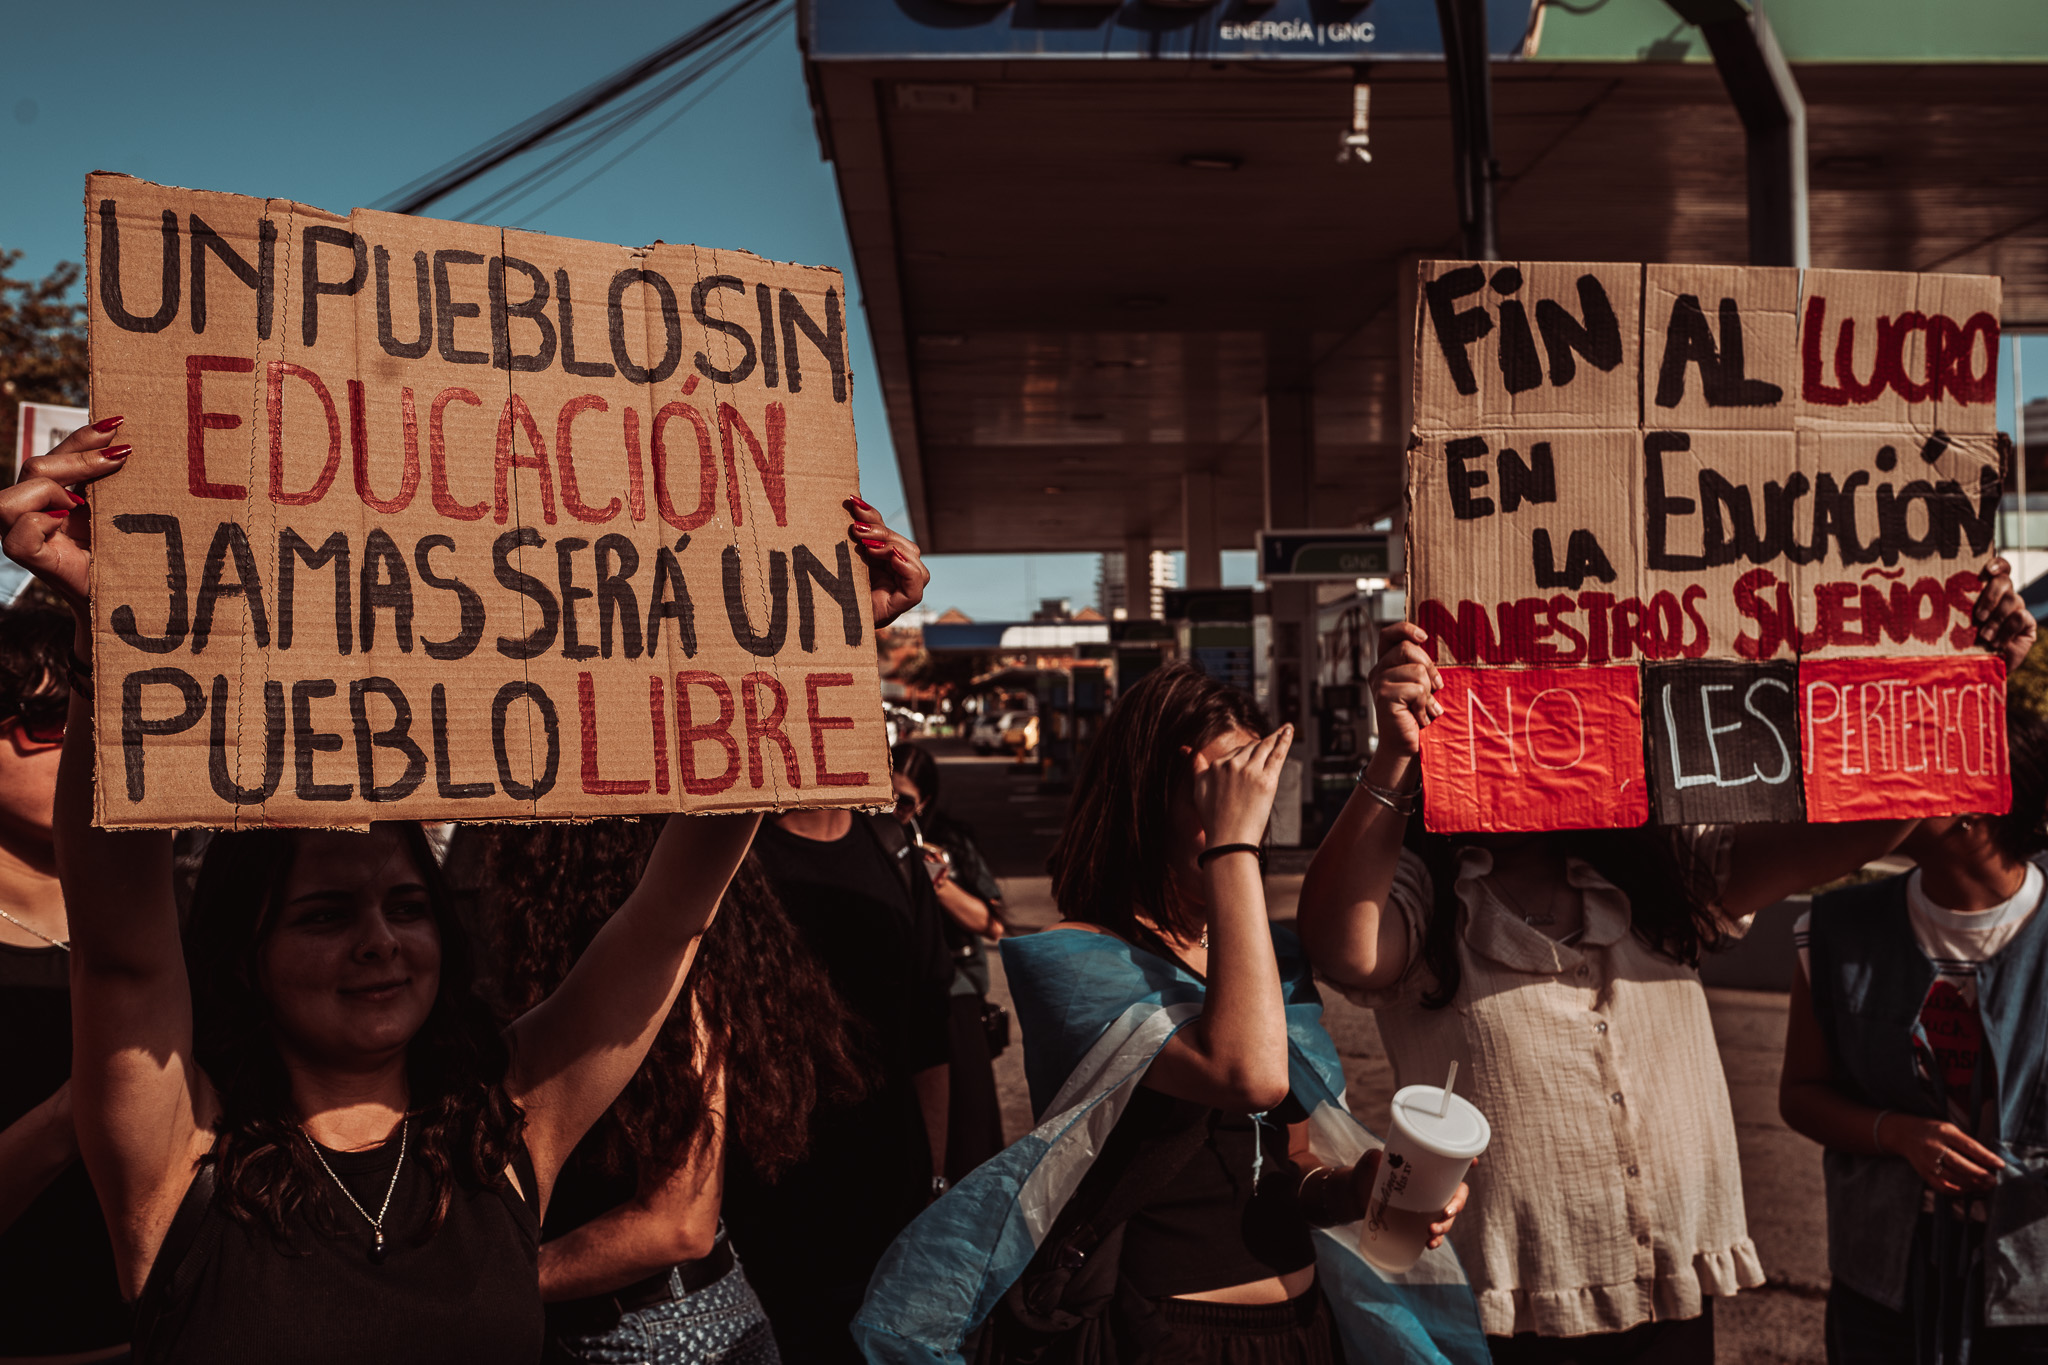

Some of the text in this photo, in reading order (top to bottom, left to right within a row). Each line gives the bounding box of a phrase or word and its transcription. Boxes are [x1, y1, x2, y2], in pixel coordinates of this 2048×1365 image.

[1219, 18, 1376, 43] ENERGÍA GNC
[99, 199, 848, 403] UN PUEBLO SIN
[1655, 294, 1783, 408] AL
[1802, 296, 1999, 406] LUCRO
[186, 354, 787, 530] EDUCACIÓN
[1445, 436, 1557, 520] EN
[110, 513, 863, 661] JAMAS SERÁ UN
[1339, 552, 1379, 572] GNC
[1532, 528, 1617, 589] LA
[1417, 568, 1984, 664] NUESTROS SUEÑOS
[121, 666, 870, 805] PUEBLO LIBRE
[1467, 677, 2010, 789] NO LES PERTENECEN
